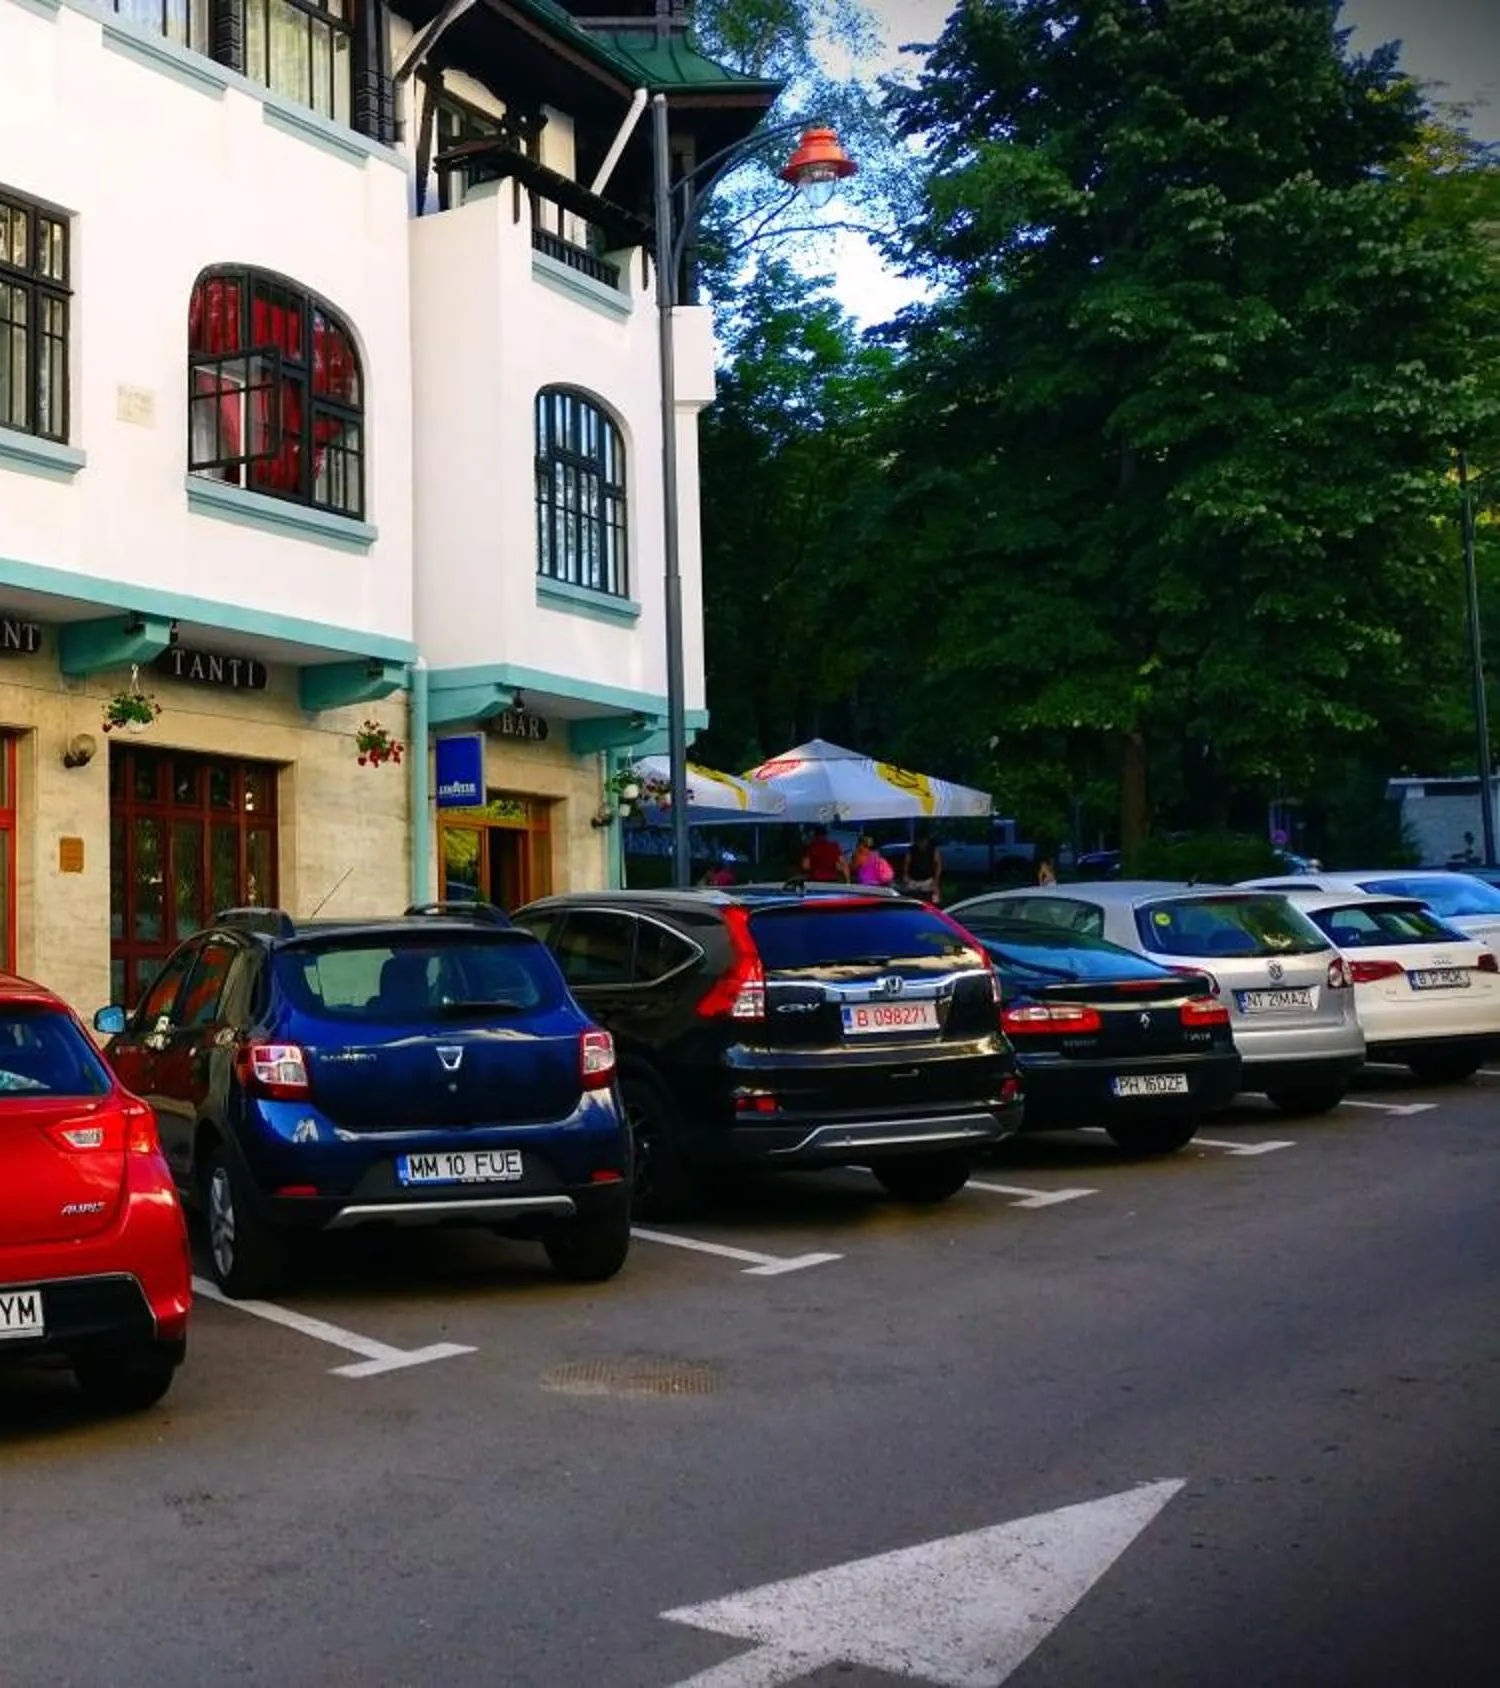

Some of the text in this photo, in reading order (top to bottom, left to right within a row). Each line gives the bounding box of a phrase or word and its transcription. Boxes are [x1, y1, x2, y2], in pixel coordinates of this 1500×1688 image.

[171, 649, 258, 687] TANTI
[502, 710, 540, 739] BAR
[856, 1009, 869, 1027] B
[410, 1151, 521, 1178] MM 10 FUE
